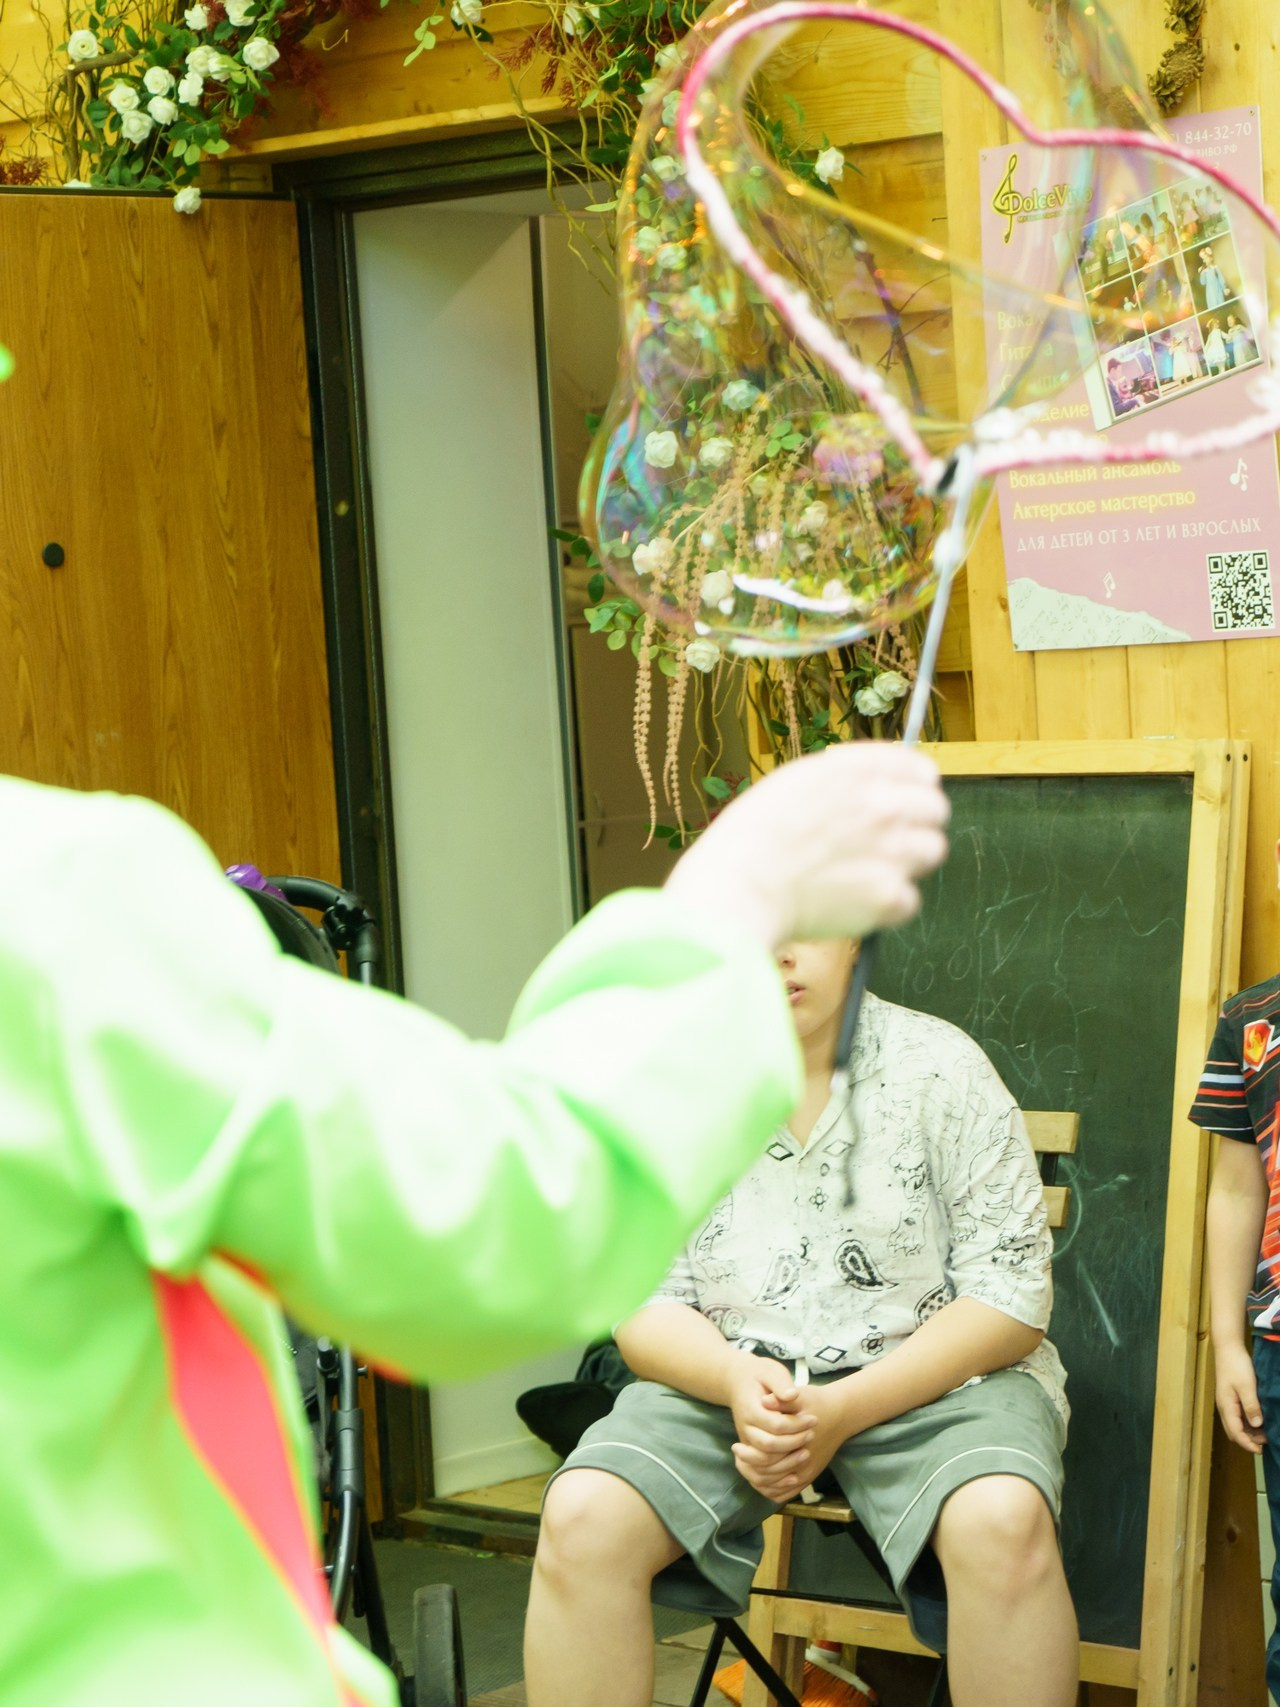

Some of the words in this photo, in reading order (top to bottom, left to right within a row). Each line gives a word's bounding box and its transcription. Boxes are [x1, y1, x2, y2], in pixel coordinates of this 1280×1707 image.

[1184, 121, 1252, 145] 844-32-70
[1008, 465, 1098, 489] Вокальный
[1012, 498, 1097, 522] Актерское
[1100, 490, 1197, 514] мастерство
[1016, 535, 1046, 552] ДЛЯ
[1049, 529, 1094, 549] ДЕТЕЙ
[1098, 529, 1118, 544] ОТ
[1122, 528, 1131, 543] 3
[1135, 525, 1161, 542] ЛЕТ
[1166, 524, 1177, 539] И
[1181, 517, 1262, 538] ВЗРОСЛЫХ
